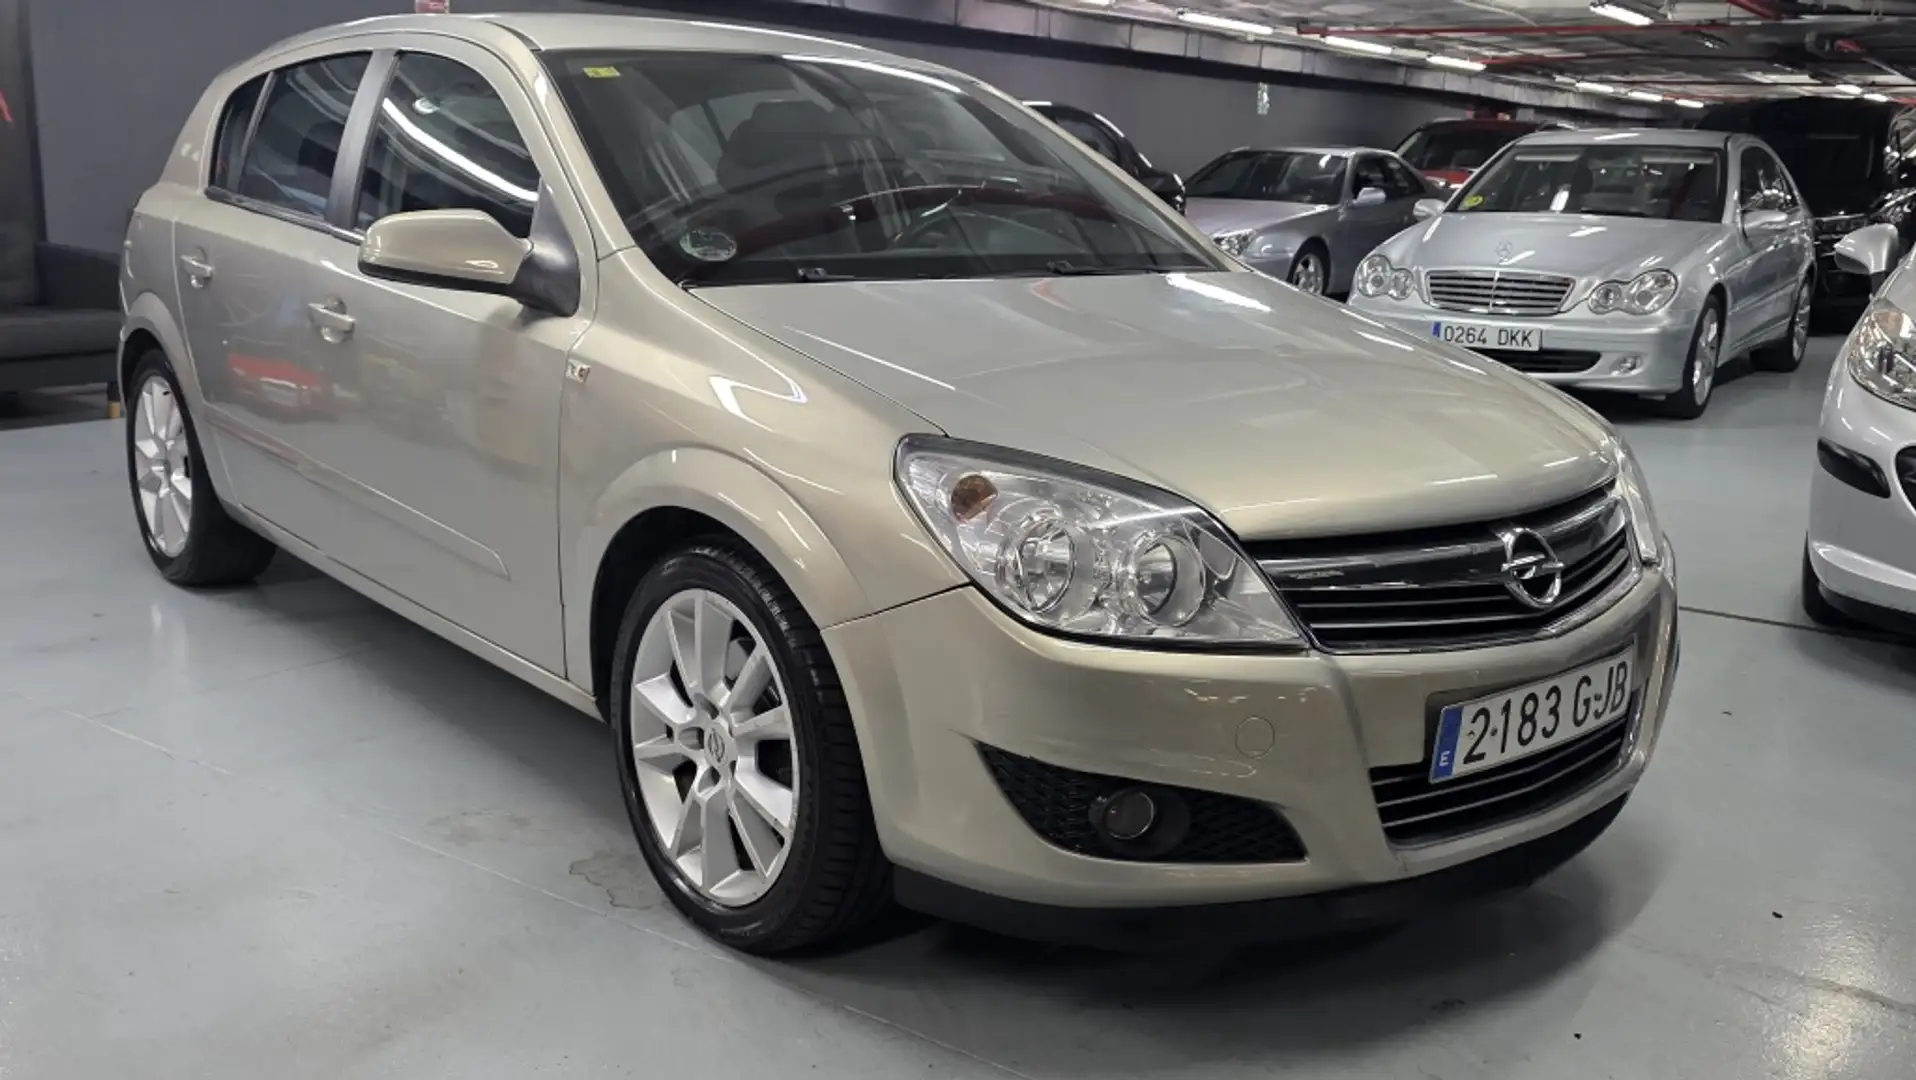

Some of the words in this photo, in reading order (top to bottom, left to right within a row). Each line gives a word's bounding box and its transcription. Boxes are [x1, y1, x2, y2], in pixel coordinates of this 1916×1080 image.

[1444, 325, 1487, 345] 0264
[1497, 328, 1533, 348] DKK
[1463, 685, 1562, 765] 2183
[1572, 660, 1628, 728] GJB
[1438, 750, 1451, 767] E
